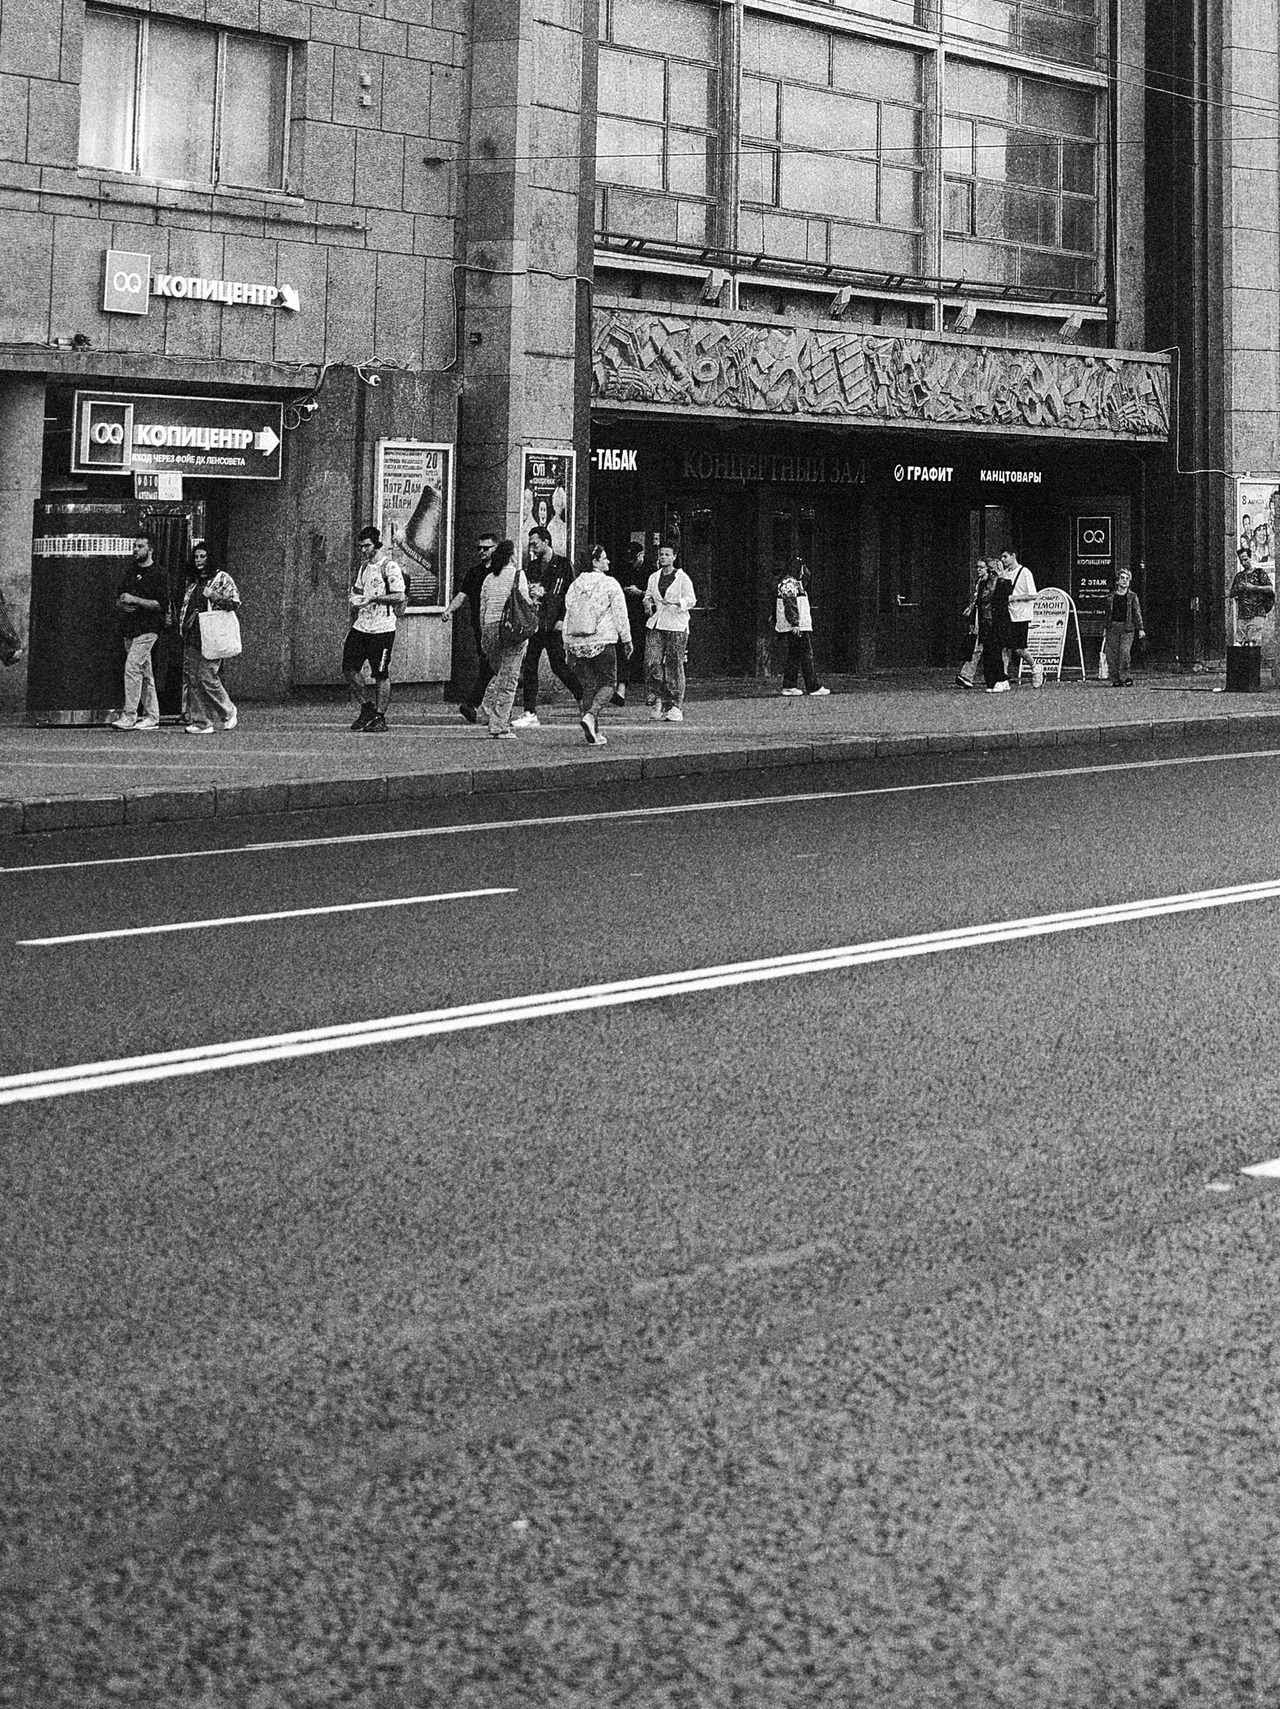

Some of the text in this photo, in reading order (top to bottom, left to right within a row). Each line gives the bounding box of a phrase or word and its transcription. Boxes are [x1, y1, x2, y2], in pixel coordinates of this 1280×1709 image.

[157, 274, 278, 305] КОПИЦЕНТР
[136, 424, 253, 451] КОПИЦЕНТР
[132, 453, 246, 466] ВХОД ЧЕРЕЗ ФОЙЕ ДК ЛЕНСОВЕТА
[426, 452, 438, 469] 20
[589, 448, 638, 470] -ТАБАК
[907, 465, 954, 482] ГРАФИТ
[980, 469, 1042, 484] КАНЦТОВАРЫ
[1242, 495, 1247, 505] 8
[1080, 578, 1087, 586] 2
